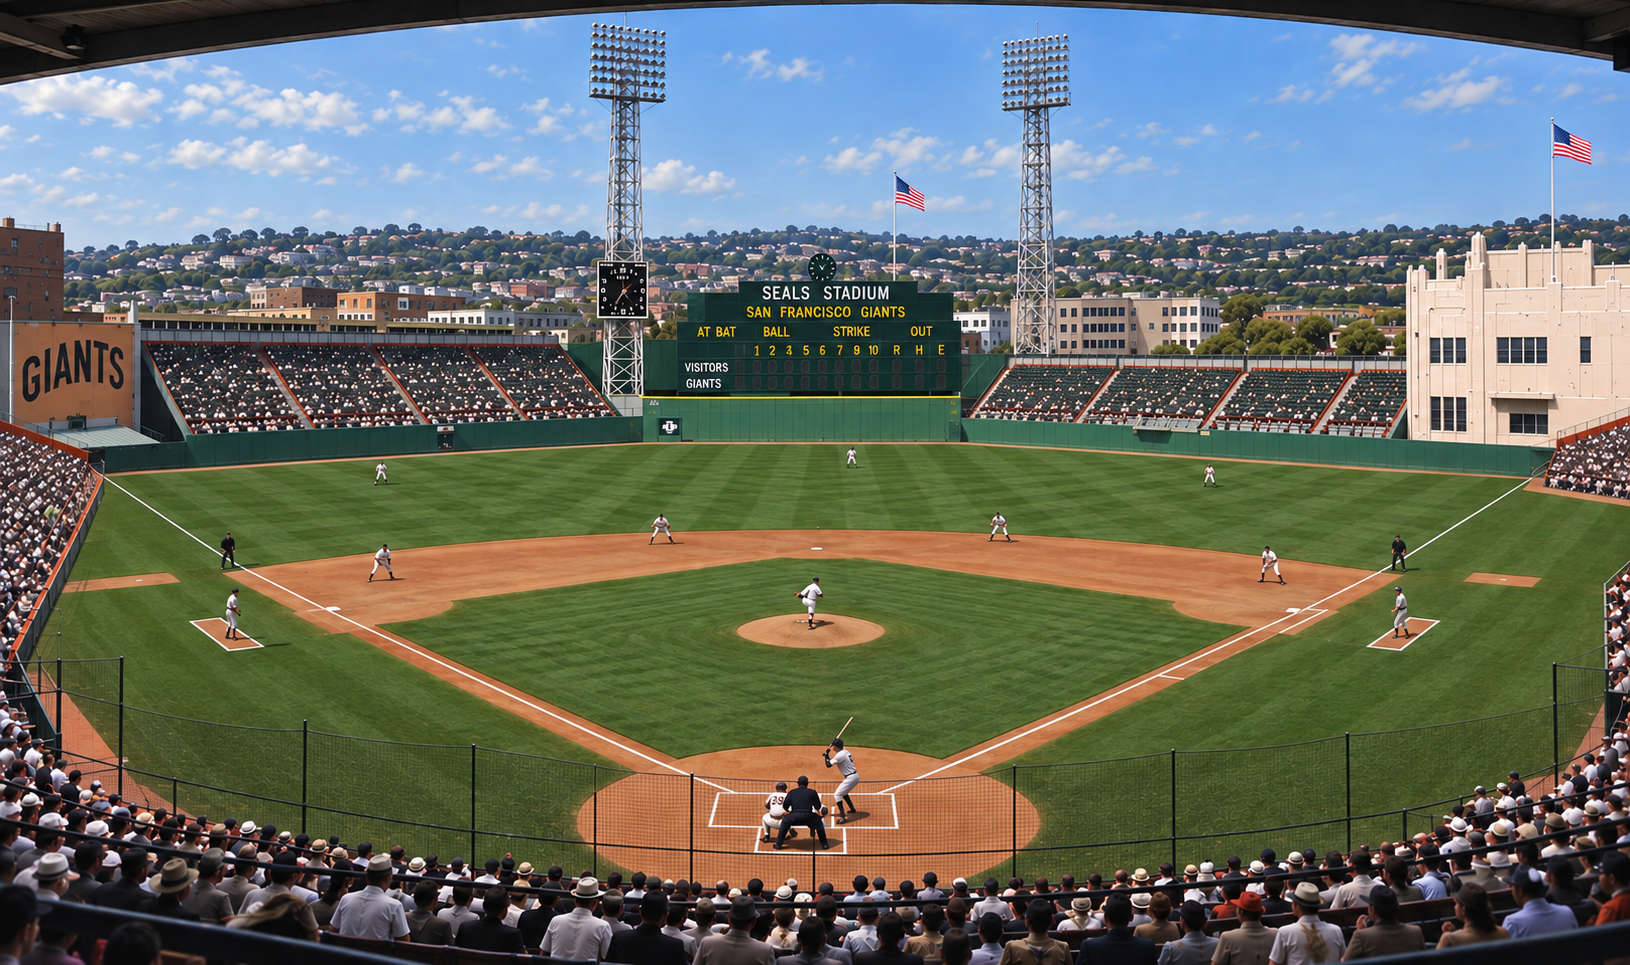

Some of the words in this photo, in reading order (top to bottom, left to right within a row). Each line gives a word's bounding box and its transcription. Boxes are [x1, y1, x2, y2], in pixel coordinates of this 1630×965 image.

[762, 285, 810, 300] SEALS
[823, 285, 890, 300] STADIUM
[746, 306, 771, 318] SAN
[780, 306, 851, 318] FRANCISCO
[860, 306, 906, 318] GIANTS
[697, 326, 711, 338] AT
[715, 326, 736, 338] BAT
[763, 326, 790, 338] BALL
[833, 326, 871, 338] STRIKE
[910, 326, 933, 337] OUT
[754, 345, 760, 356] 1
[769, 345, 776, 356] 2
[802, 345, 810, 356] 5
[819, 345, 826, 356] 6
[836, 345, 843, 356] 7
[853, 345, 860, 356] 9
[868, 345, 879, 356] 10
[893, 345, 901, 356] R
[915, 345, 923, 356] H
[938, 345, 945, 356] E
[22, 339, 124, 402] GIANTS
[684, 362, 729, 373] VISITORS
[685, 379, 722, 389] GIANTS
